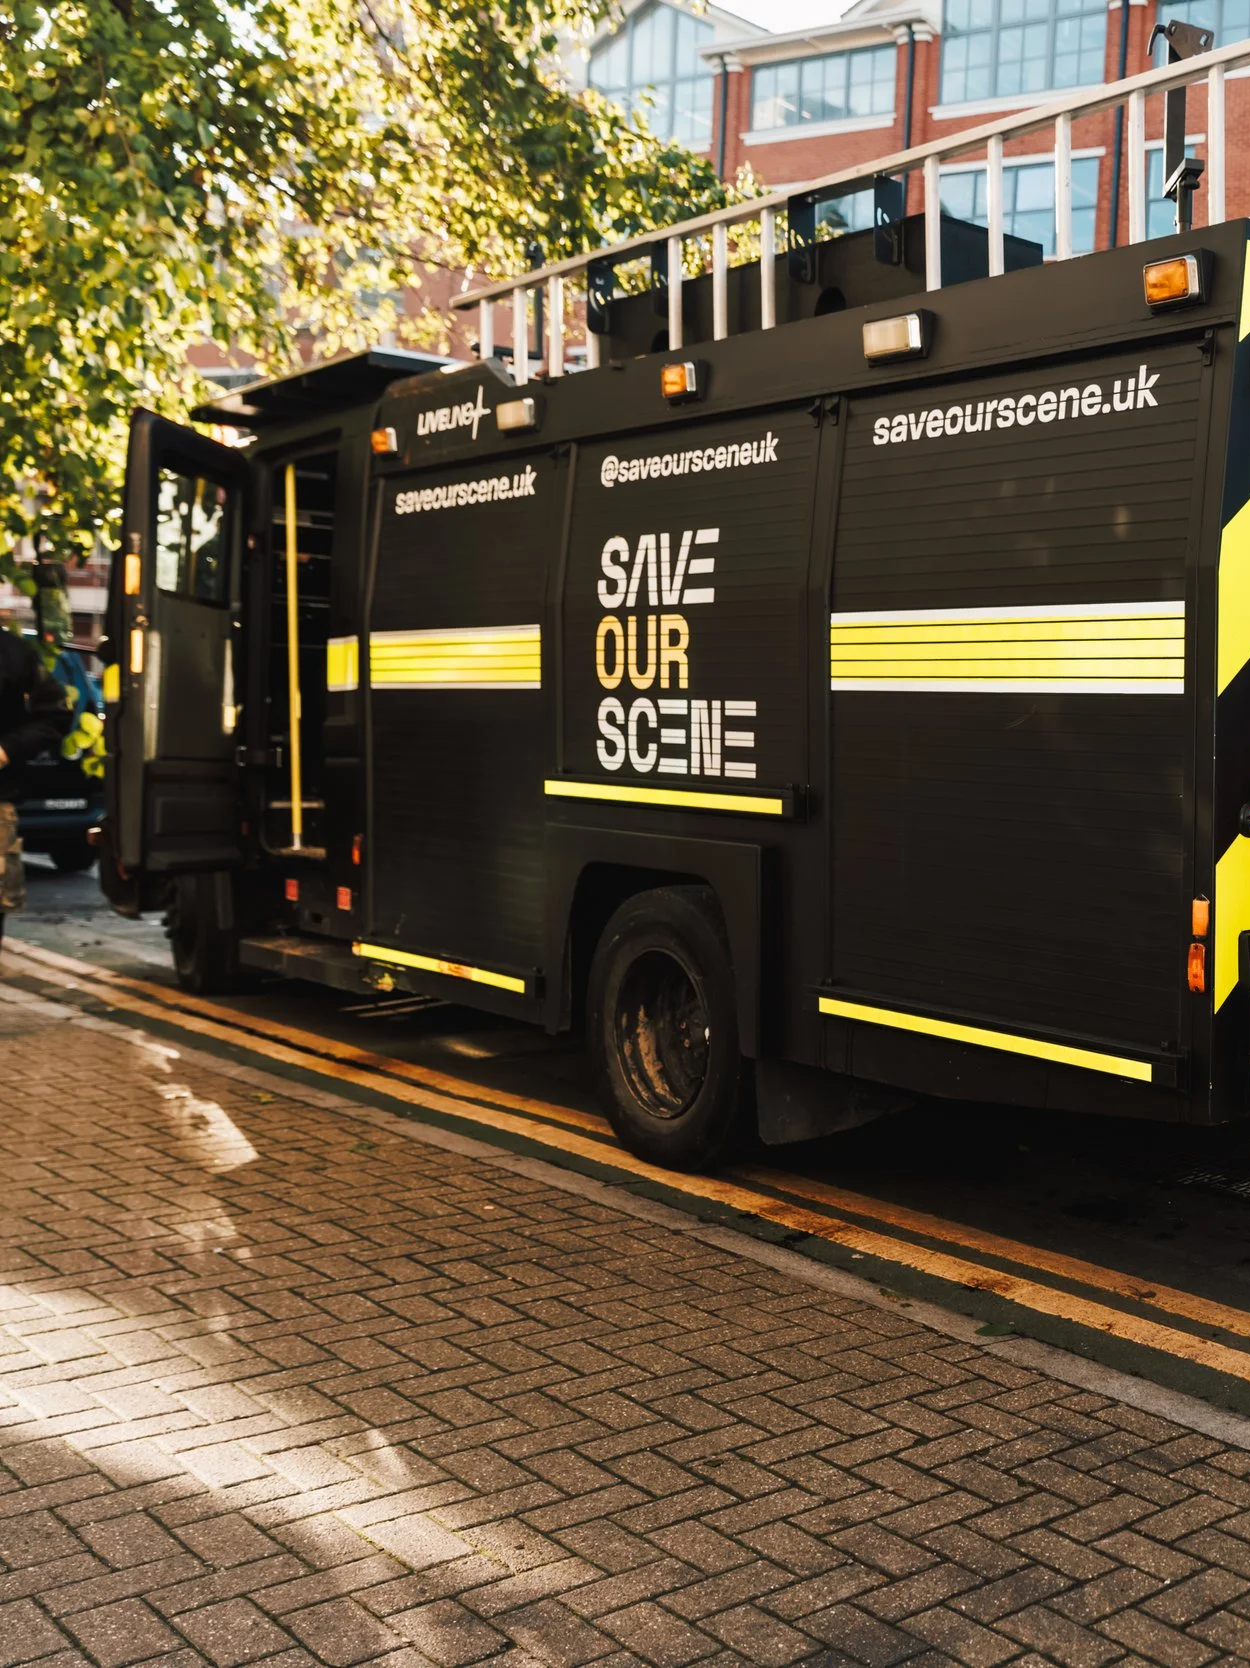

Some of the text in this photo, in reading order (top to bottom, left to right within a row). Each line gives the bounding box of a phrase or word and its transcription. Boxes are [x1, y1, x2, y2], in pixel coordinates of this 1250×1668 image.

[872, 364, 1161, 446] saveourscene.uk
[395, 464, 537, 515] saveourscene.uk
[600, 431, 780, 488] @saveoursceneuk
[597, 527, 720, 609] SAVE
[595, 613, 690, 690] OUR
[596, 696, 757, 779] SCENE
